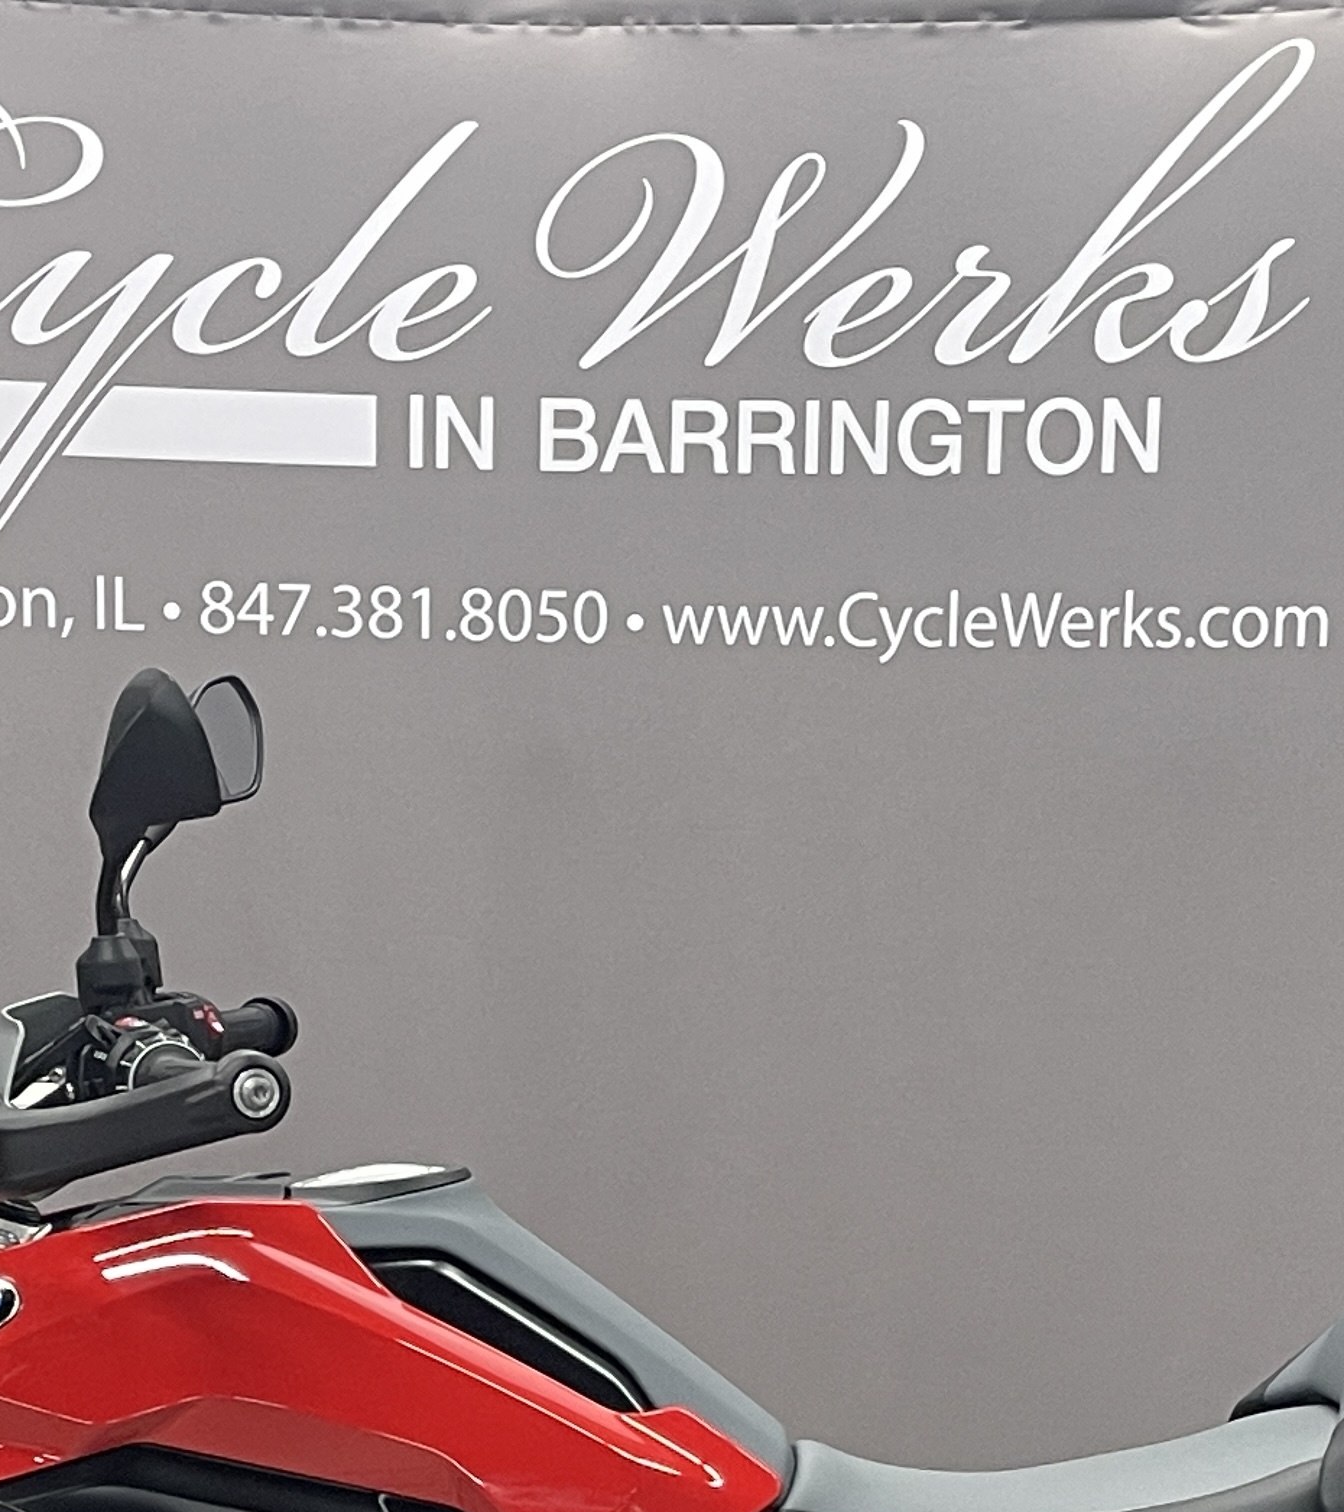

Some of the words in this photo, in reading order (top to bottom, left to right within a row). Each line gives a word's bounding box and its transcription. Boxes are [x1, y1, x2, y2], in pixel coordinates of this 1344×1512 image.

[534, 37, 1316, 370] Werks
[408, 393, 495, 472] IN
[538, 395, 1162, 478] BARRINGTON
[95, 573, 146, 632] IL
[199, 579, 609, 645] 847.381.8050
[661, 588, 1330, 665] www.CycleWerks.com
